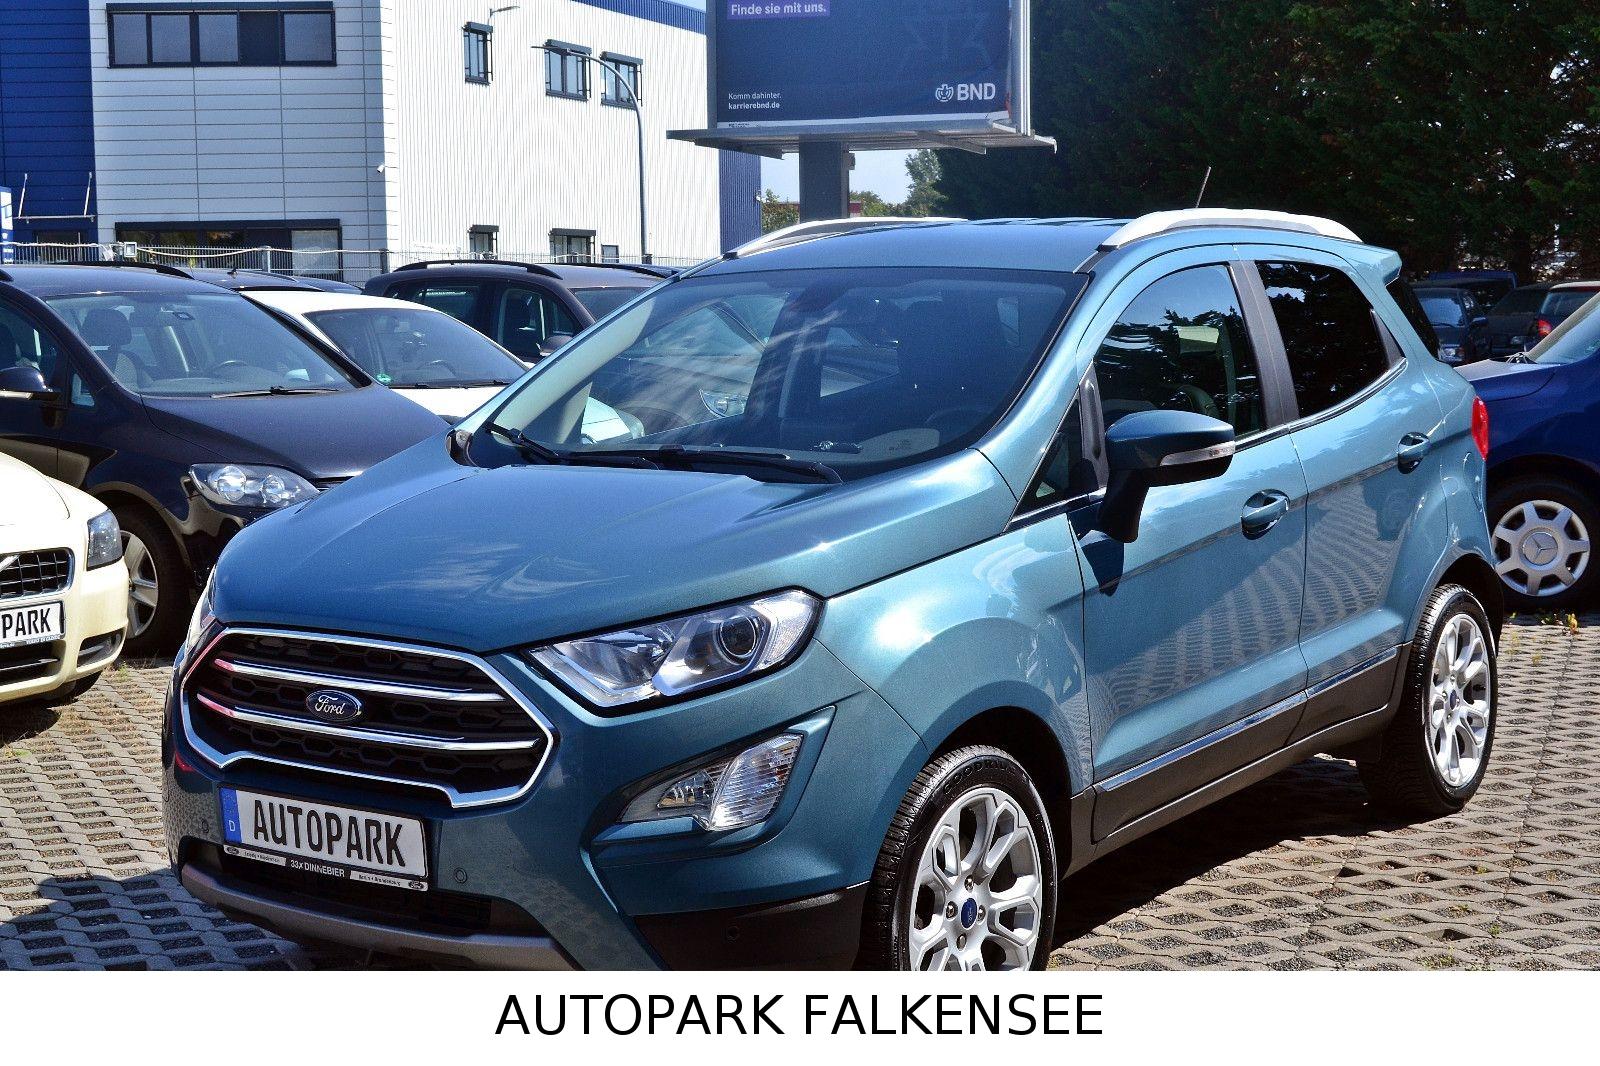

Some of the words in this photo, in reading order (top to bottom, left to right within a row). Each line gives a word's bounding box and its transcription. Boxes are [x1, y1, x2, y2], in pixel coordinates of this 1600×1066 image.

[731, 3, 762, 15] Finde
[764, 3, 781, 14] sie
[783, 2, 801, 13] mit
[804, 2, 827, 13] uns.
[957, 82, 996, 101] BND
[728, 101, 781, 109] karrierebnd.de
[2, 608, 51, 638] PARK
[314, 694, 346, 715] Ford
[228, 820, 236, 832] D
[253, 800, 406, 867] AUTOPARK
[304, 862, 345, 877] DINNEBIER
